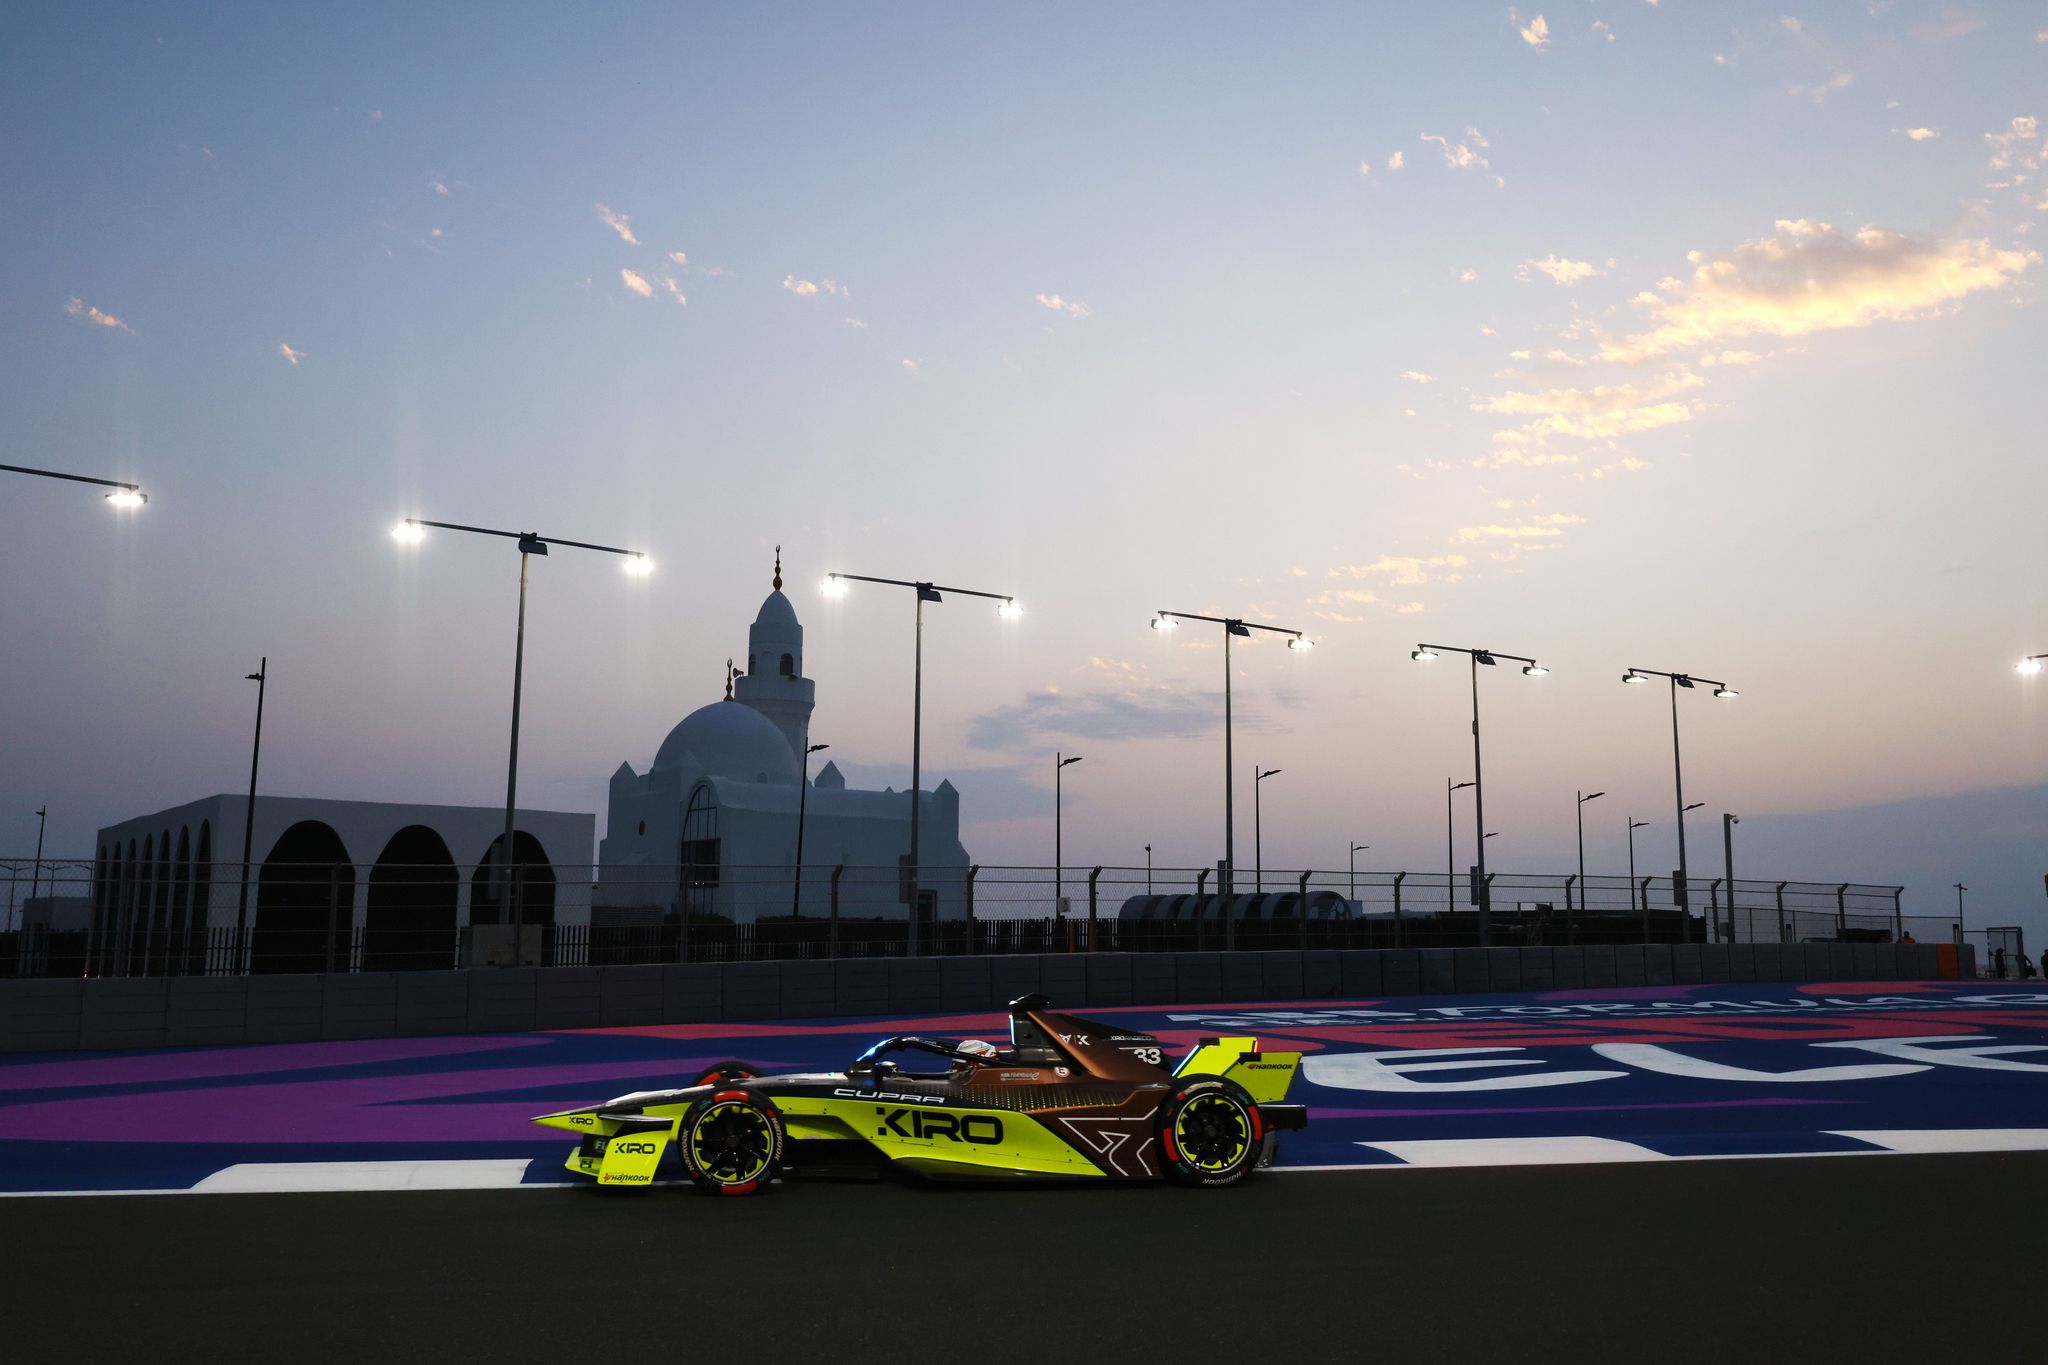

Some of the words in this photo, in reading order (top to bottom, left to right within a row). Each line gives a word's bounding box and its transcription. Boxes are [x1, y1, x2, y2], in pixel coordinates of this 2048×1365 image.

[1166, 1010, 1416, 1021] ABB
[1418, 997, 1956, 1016] FORMULA
[1134, 1049, 1161, 1065] 33
[834, 1088, 945, 1103] CUPRA
[569, 1116, 594, 1125] KIRO
[876, 1107, 1004, 1145] KIRO
[615, 1142, 656, 1154] KIRO
